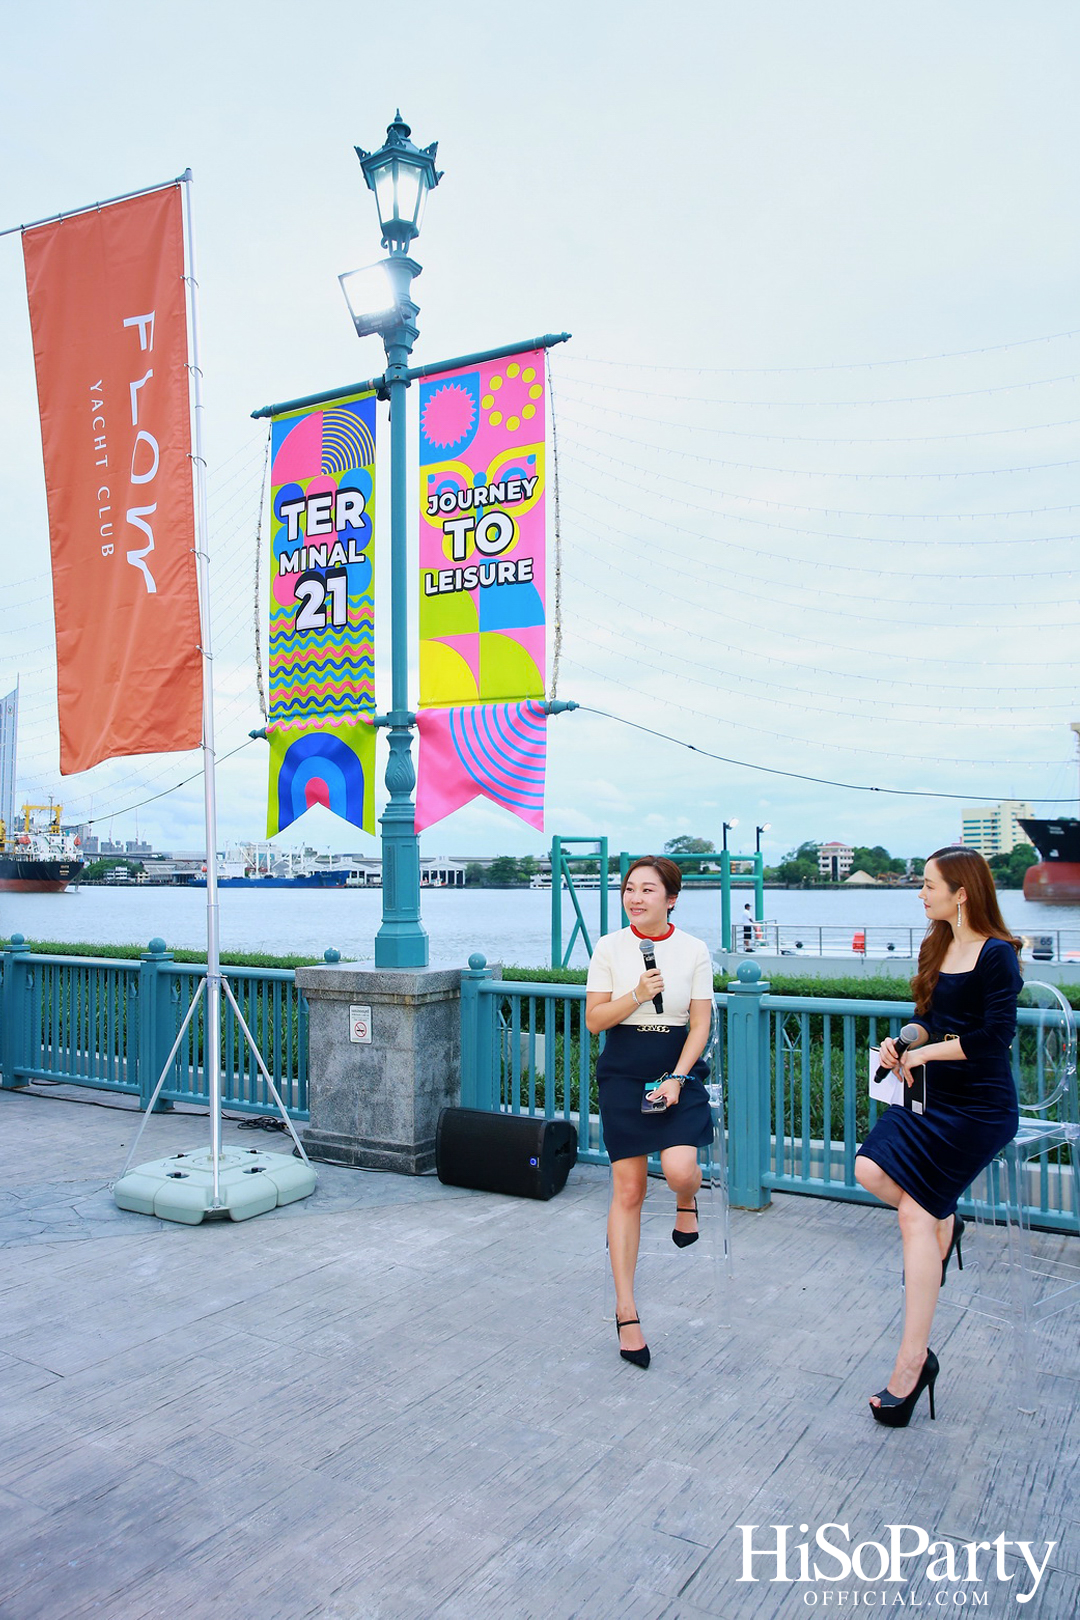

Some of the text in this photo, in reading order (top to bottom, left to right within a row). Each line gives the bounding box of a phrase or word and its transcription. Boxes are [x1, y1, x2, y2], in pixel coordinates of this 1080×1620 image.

[90, 380, 114, 557] YACHT CLUB
[123, 310, 159, 593] FLOW
[279, 487, 366, 542] TER
[427, 476, 539, 516] JOURNEY
[279, 538, 366, 576] MINAL
[443, 511, 515, 561] TO
[294, 567, 348, 632] 21
[425, 557, 534, 597] LEISURE
